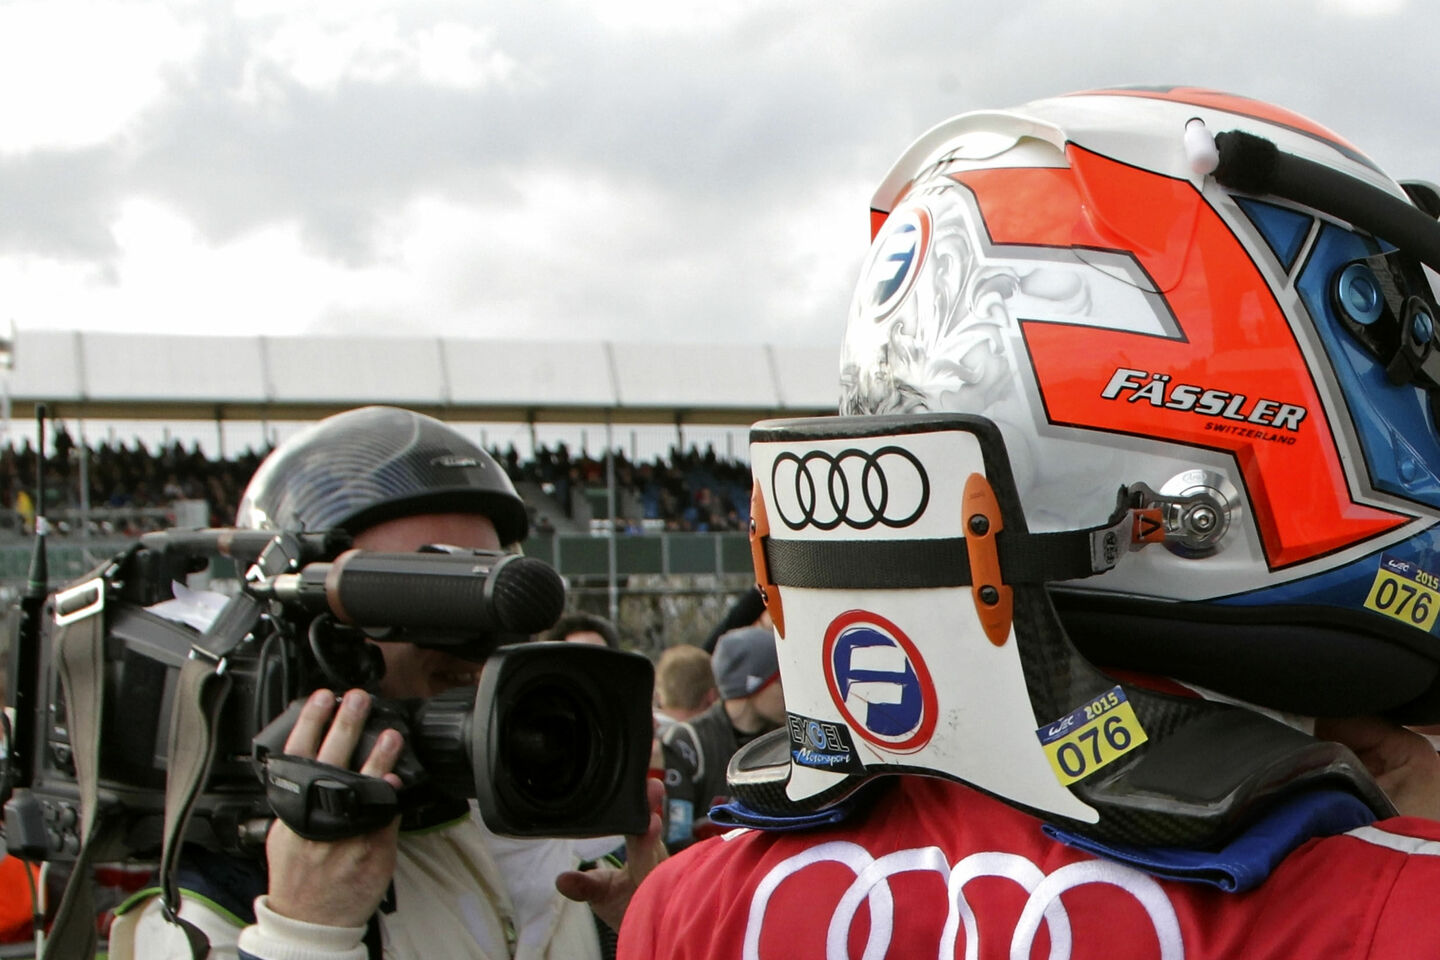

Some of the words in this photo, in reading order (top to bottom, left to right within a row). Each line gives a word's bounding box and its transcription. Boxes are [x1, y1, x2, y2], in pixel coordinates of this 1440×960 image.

[1101, 367, 1307, 432] FÄSSLER
[1204, 421, 1297, 446] SWITZERLAND
[1375, 578, 1432, 624] 076
[1415, 569, 1440, 590] 2015
[1048, 715, 1074, 736] WEC
[1084, 692, 1118, 720] 2015
[1057, 716, 1131, 777] 076
